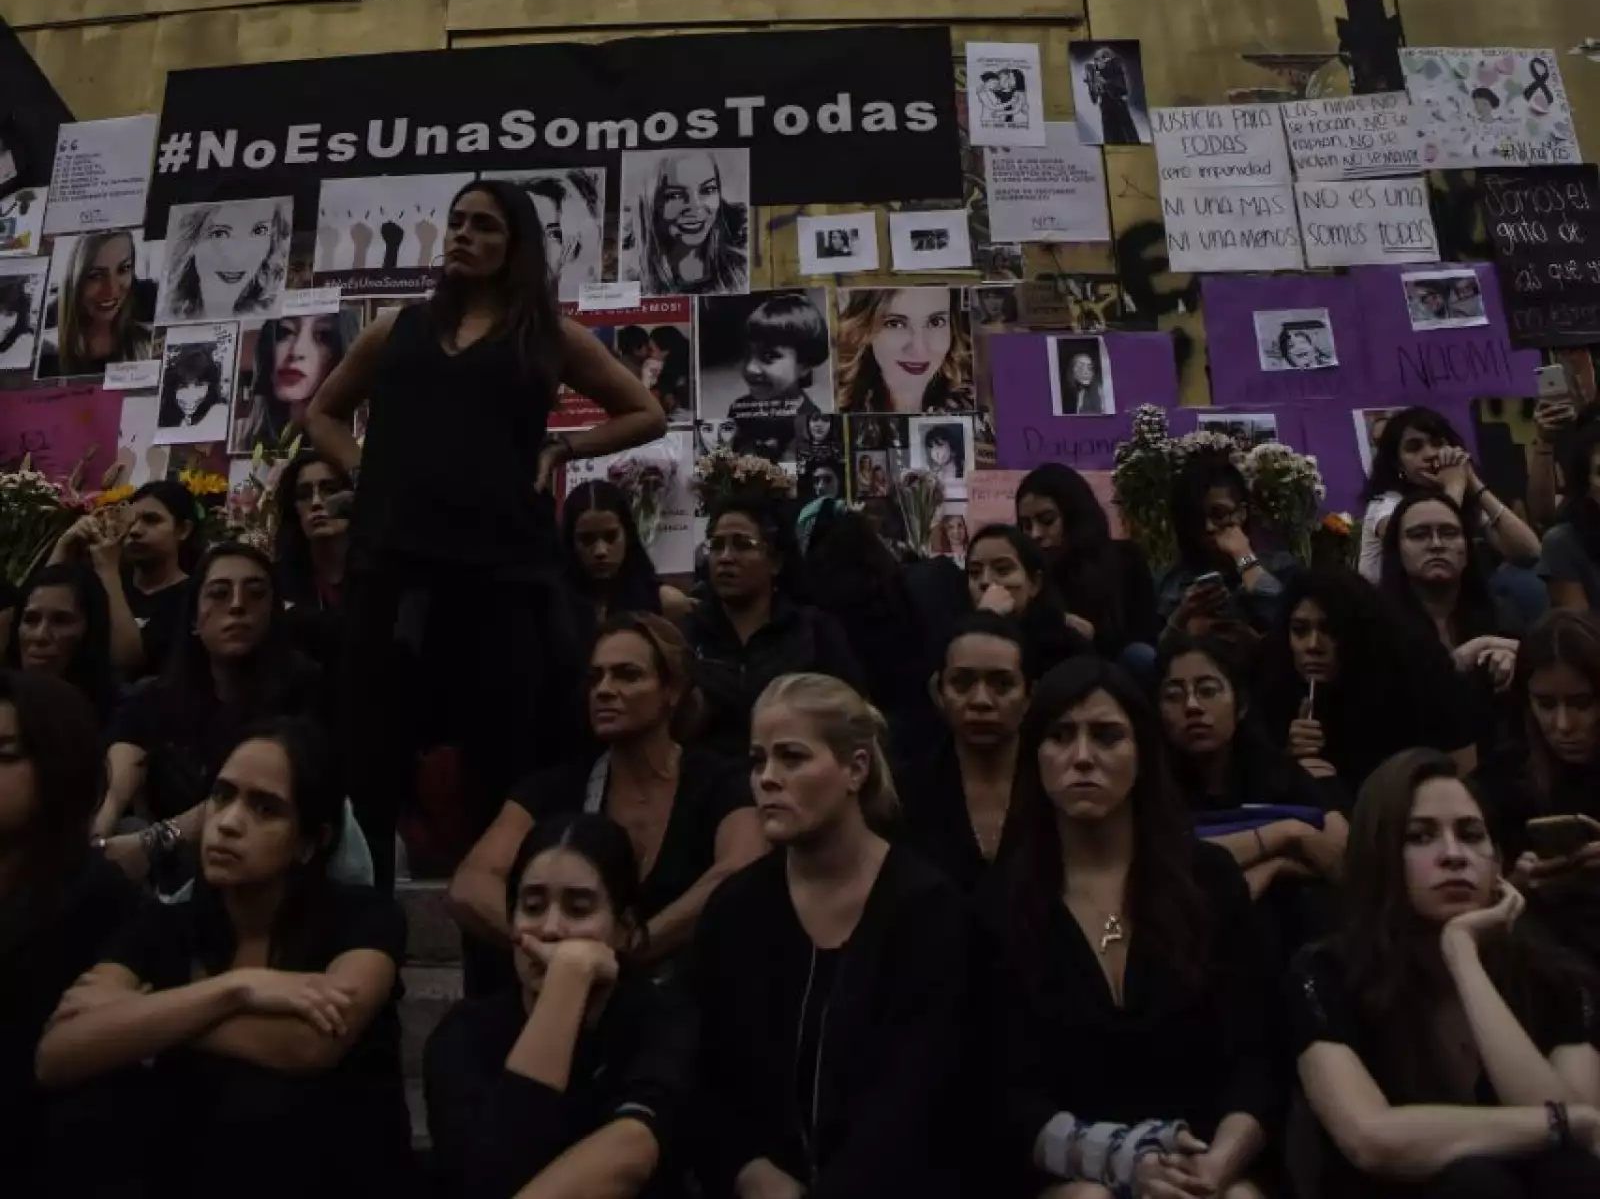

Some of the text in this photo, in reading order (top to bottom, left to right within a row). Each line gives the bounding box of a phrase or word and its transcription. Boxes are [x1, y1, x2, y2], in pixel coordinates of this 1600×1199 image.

[158, 92, 938, 174] #NoEsUnaSomosTodas
[1181, 134, 1248, 155] TODAS
[1303, 188, 1339, 209] NO
[1396, 338, 1512, 390] NAOMI
